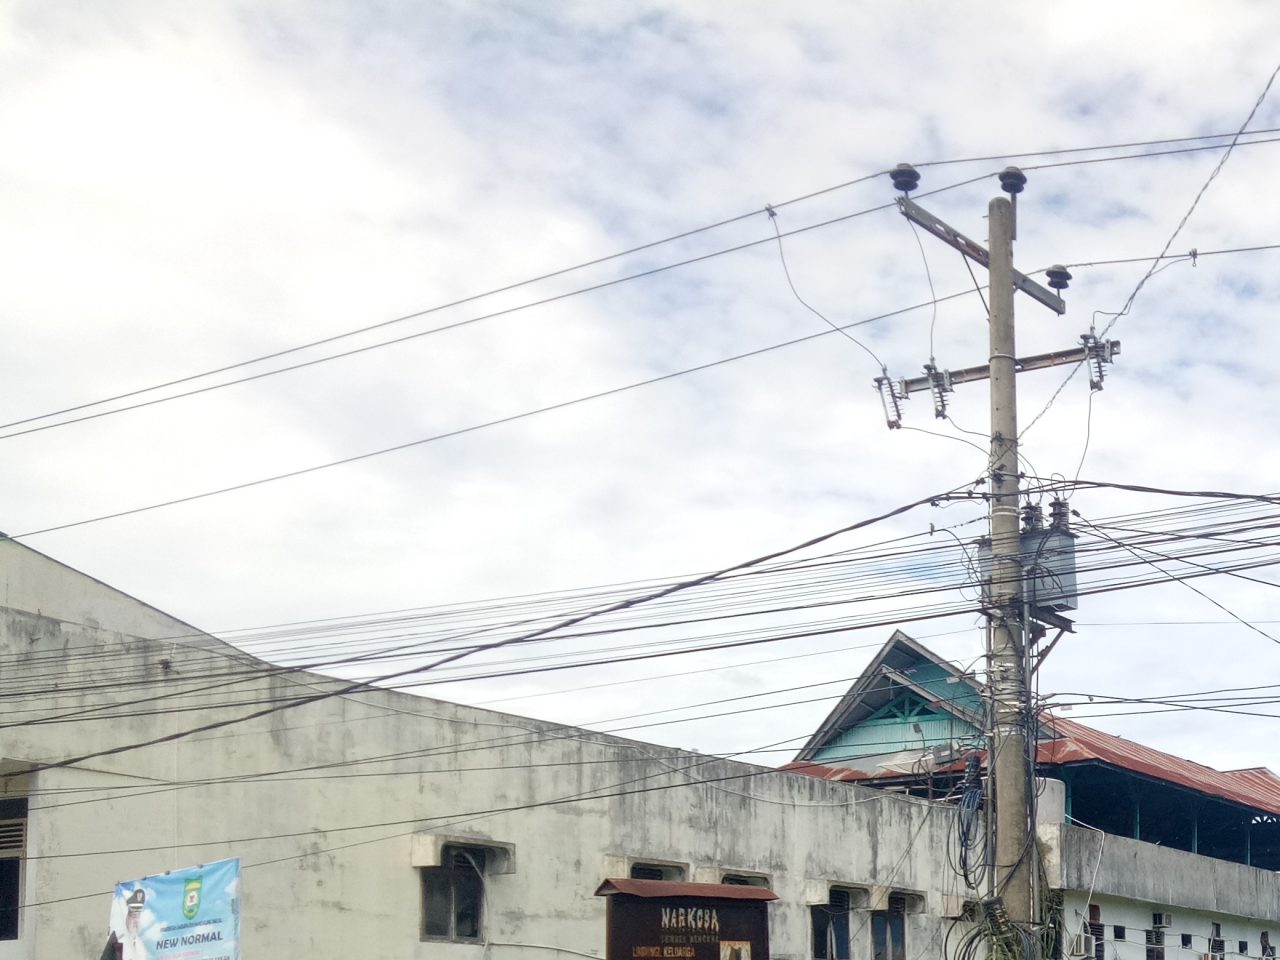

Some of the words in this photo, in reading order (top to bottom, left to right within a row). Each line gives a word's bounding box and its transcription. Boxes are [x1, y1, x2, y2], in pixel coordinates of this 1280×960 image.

[661, 906, 719, 932] NARKOBA
[156, 937, 179, 950] NEW
[181, 930, 224, 947] NORMAL
